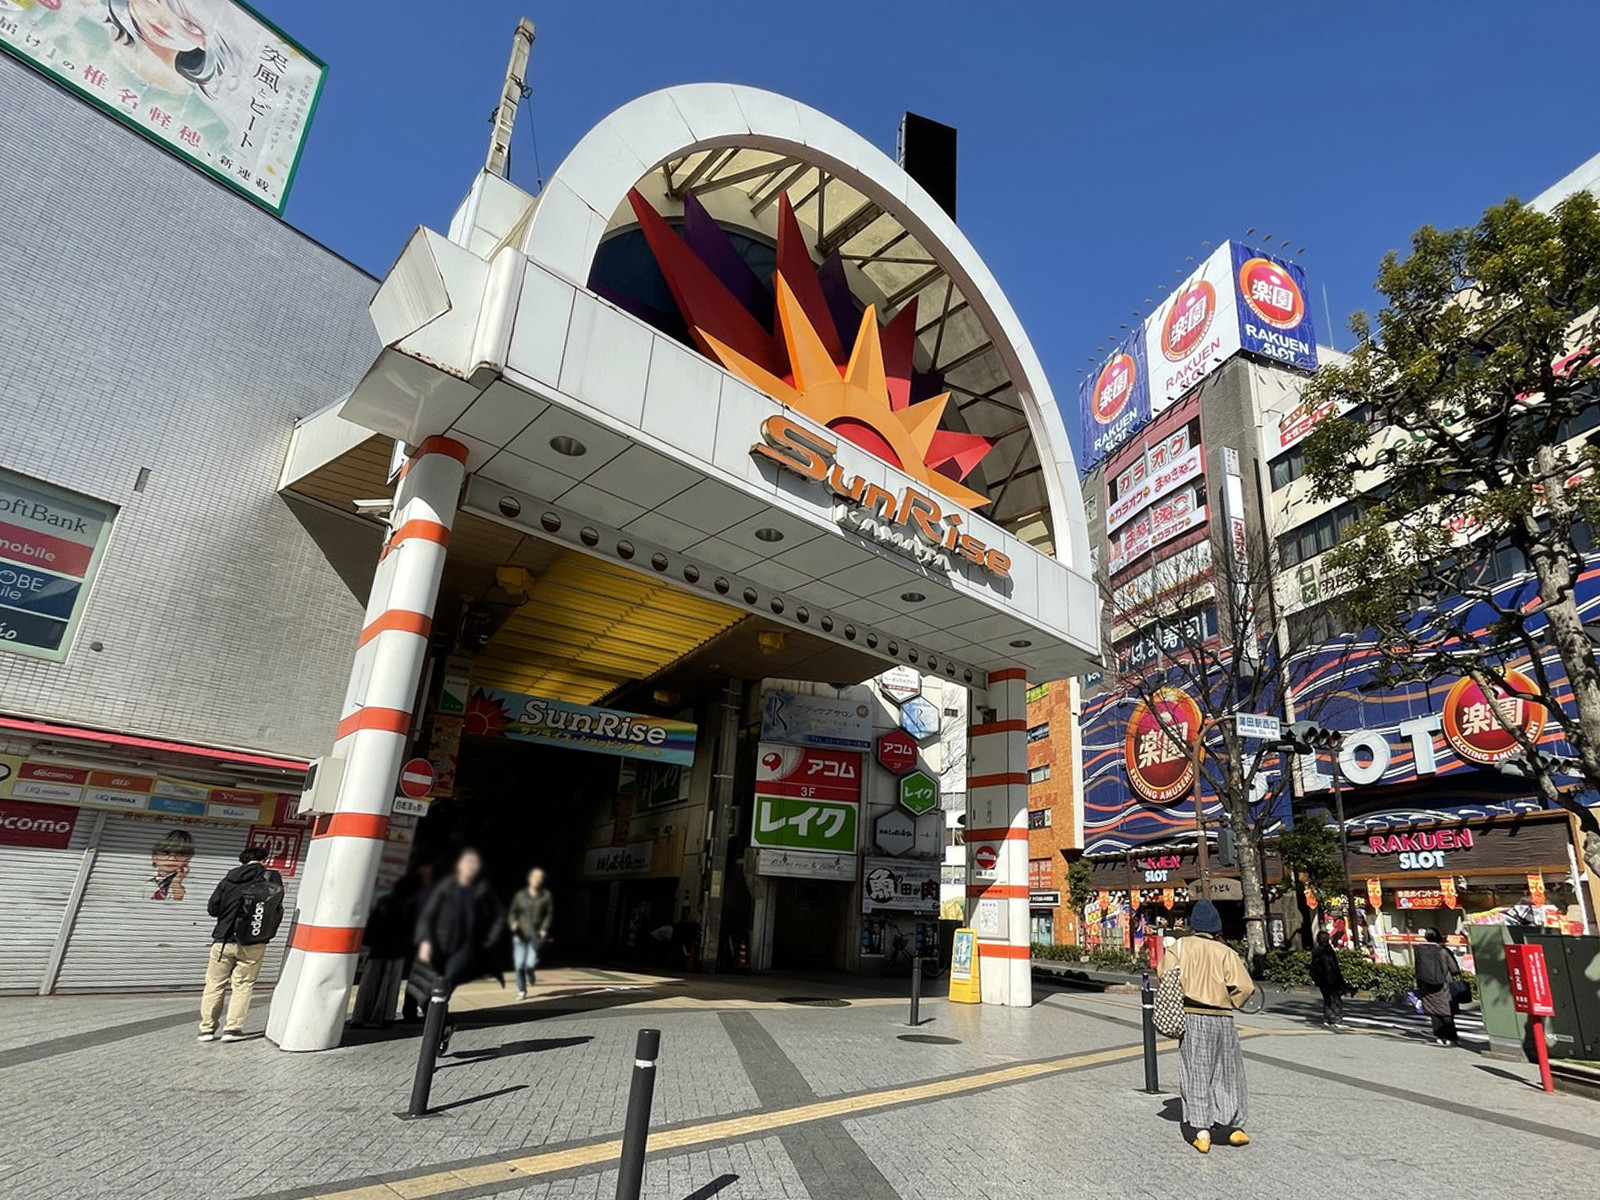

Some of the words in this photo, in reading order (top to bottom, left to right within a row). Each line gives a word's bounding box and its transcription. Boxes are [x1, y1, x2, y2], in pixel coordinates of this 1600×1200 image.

[1252, 279, 1293, 312] 楽園
[1170, 296, 1207, 348] 楽園
[1245, 324, 1309, 355] RAKUEN
[1263, 343, 1296, 362] SLOT
[1165, 337, 1221, 391] RAKUEN
[1180, 363, 1207, 392] SLOT
[1099, 368, 1128, 412] 楽園
[1094, 408, 1138, 450] RAKUEN
[1105, 428, 1128, 452] SLOT
[1120, 434, 1187, 494] カラオケ
[749, 415, 1012, 578] SunRise
[1113, 490, 1145, 520] カラオケ
[518, 699, 668, 745] SunRise
[1462, 697, 1524, 737] 楽園
[883, 742, 913, 755] アコム
[1139, 720, 1189, 769] 楽園
[1451, 735, 1490, 761] EXCITING
[1492, 720, 1540, 761] AMUSENT
[33, 769, 73, 780] docomo
[111, 777, 131, 787] au
[807, 758, 855, 780] アコム
[1130, 767, 1158, 800] EXCITING
[800, 786, 816, 798] 3F
[904, 786, 934, 799] レイク
[758, 802, 847, 838] レイク
[1369, 828, 1474, 854] RAKUEN
[1399, 850, 1446, 870] SLOT
[1145, 870, 1168, 883] SLOT
[251, 901, 265, 936] adidas
